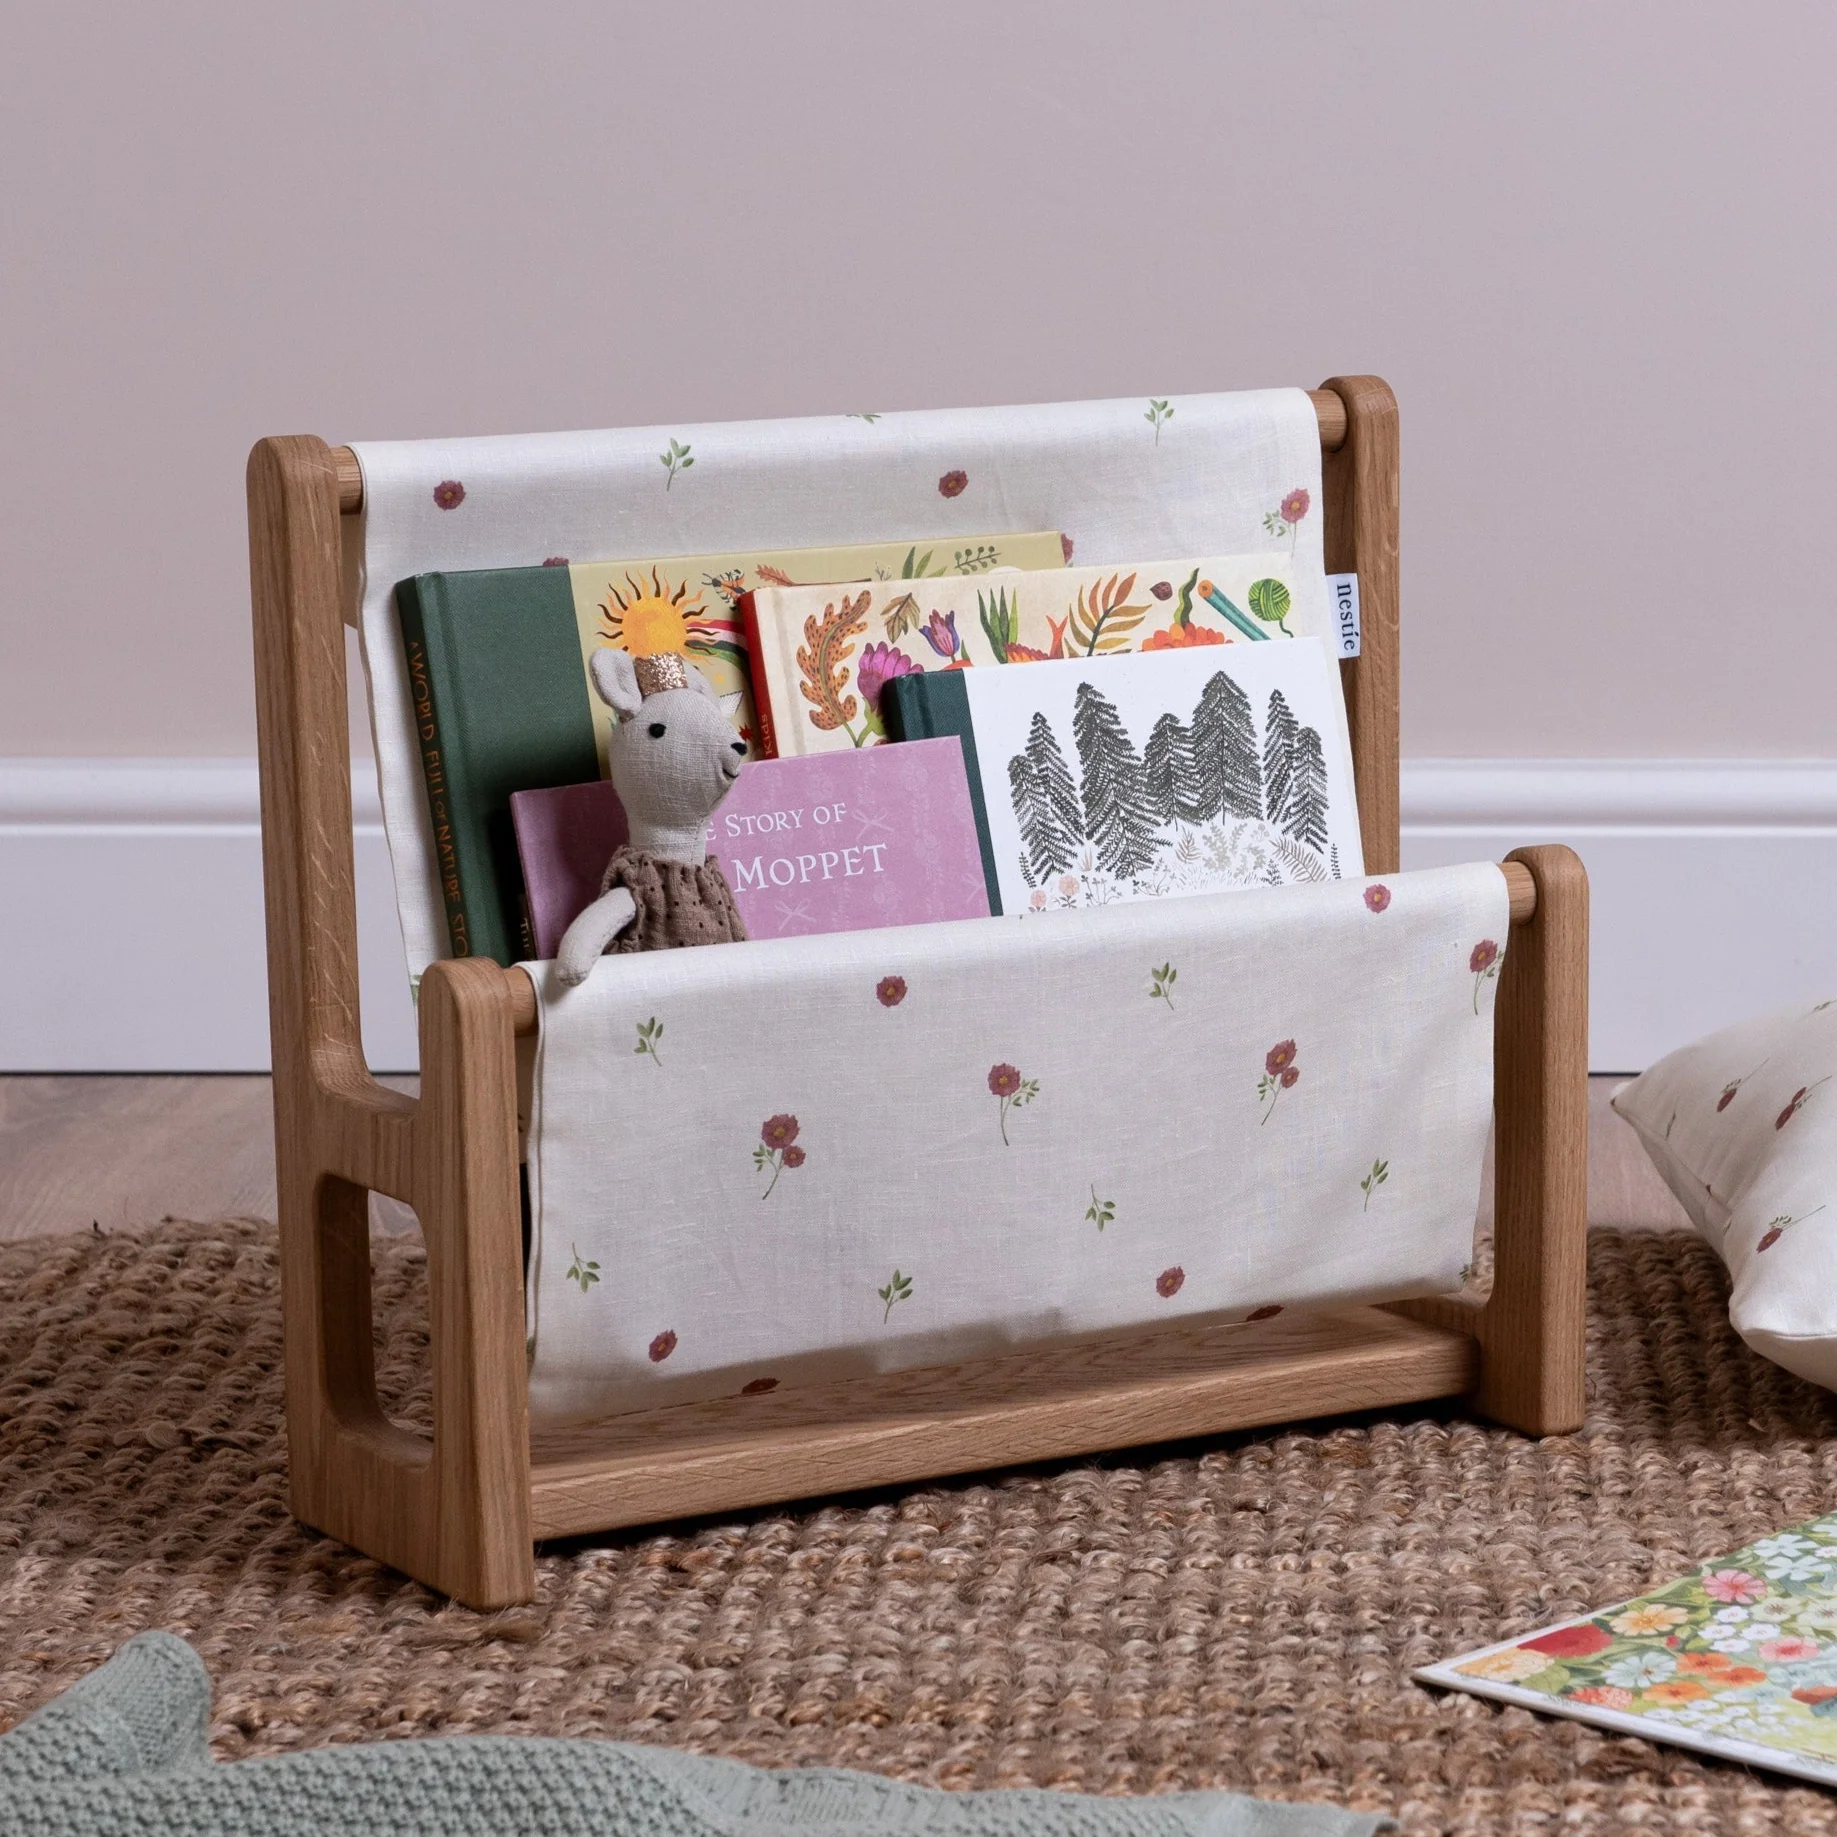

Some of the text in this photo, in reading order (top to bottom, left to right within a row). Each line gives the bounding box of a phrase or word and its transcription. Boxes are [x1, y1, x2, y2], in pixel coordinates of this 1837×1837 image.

[410, 652, 435, 741] WORLD
[425, 751, 444, 795] FULL
[436, 825, 461, 902] NATURE
[725, 808, 804, 837] STORY
[813, 802, 848, 824] OF
[731, 842, 888, 893] MOPPET
